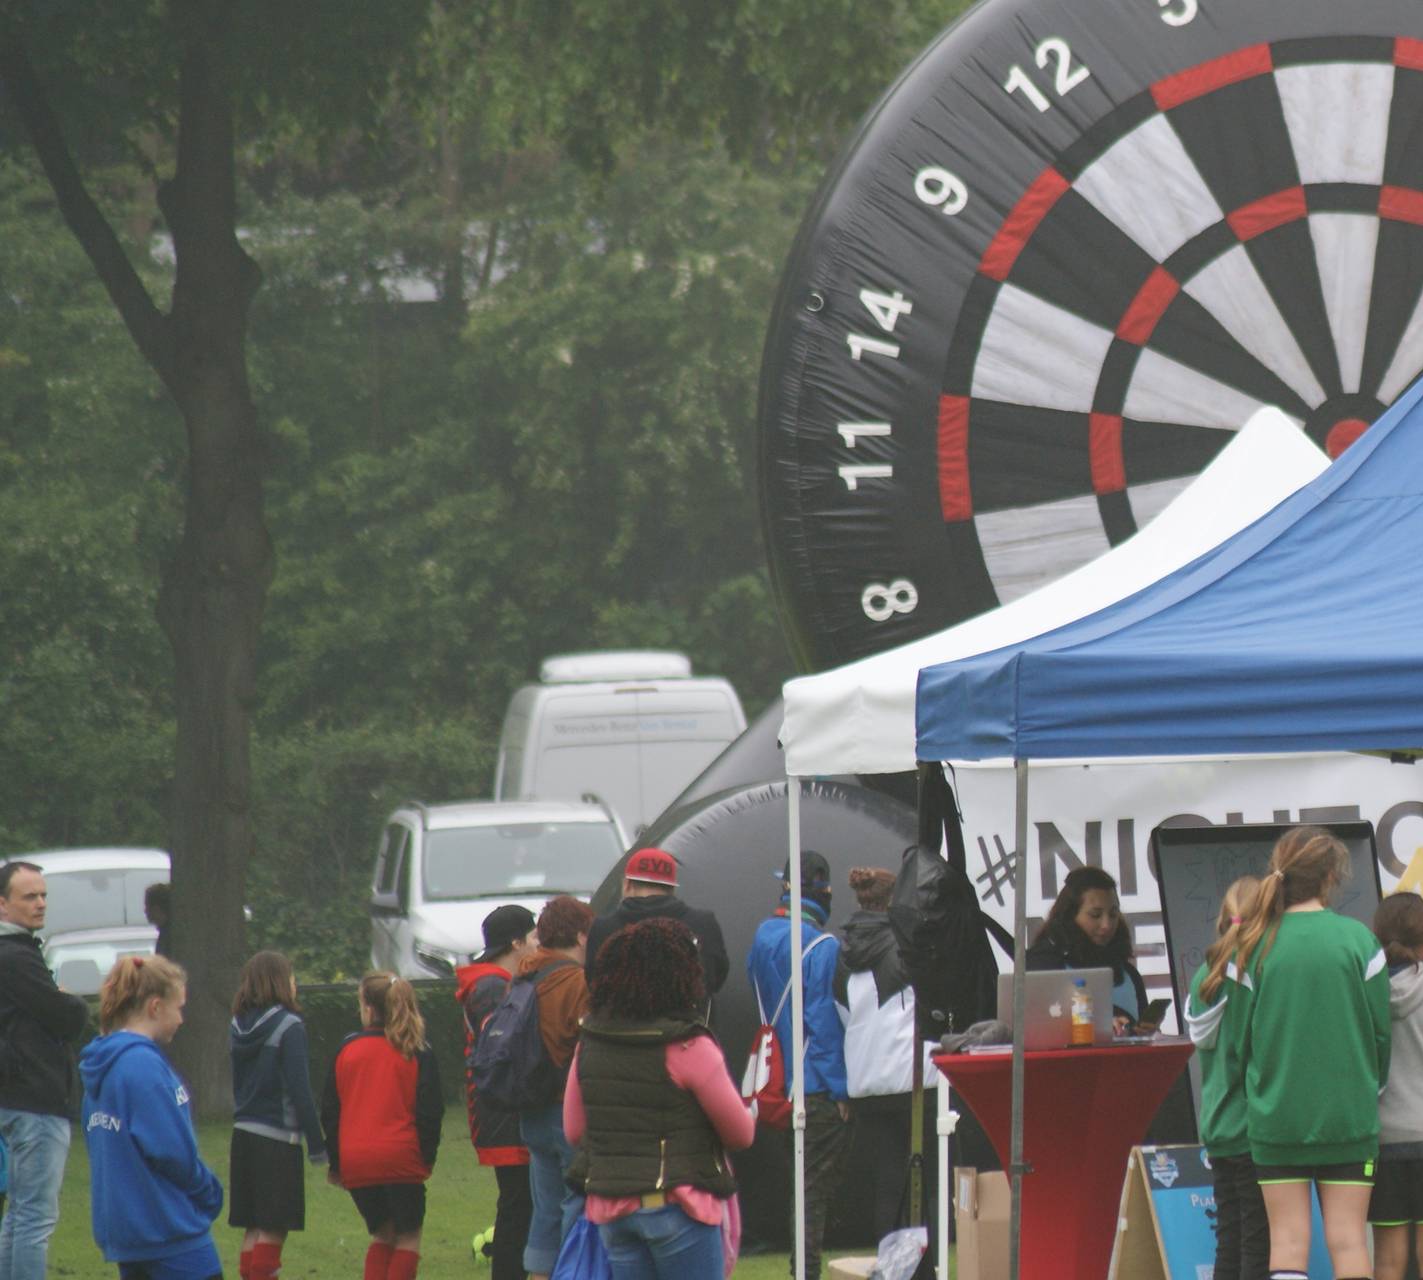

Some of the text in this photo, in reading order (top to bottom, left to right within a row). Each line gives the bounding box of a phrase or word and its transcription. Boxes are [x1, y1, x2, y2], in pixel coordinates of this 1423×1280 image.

[1004, 37, 1091, 112] 12
[913, 166, 969, 216] 9
[846, 289, 912, 361] 14
[837, 421, 893, 491] 11
[861, 579, 919, 622] 8
